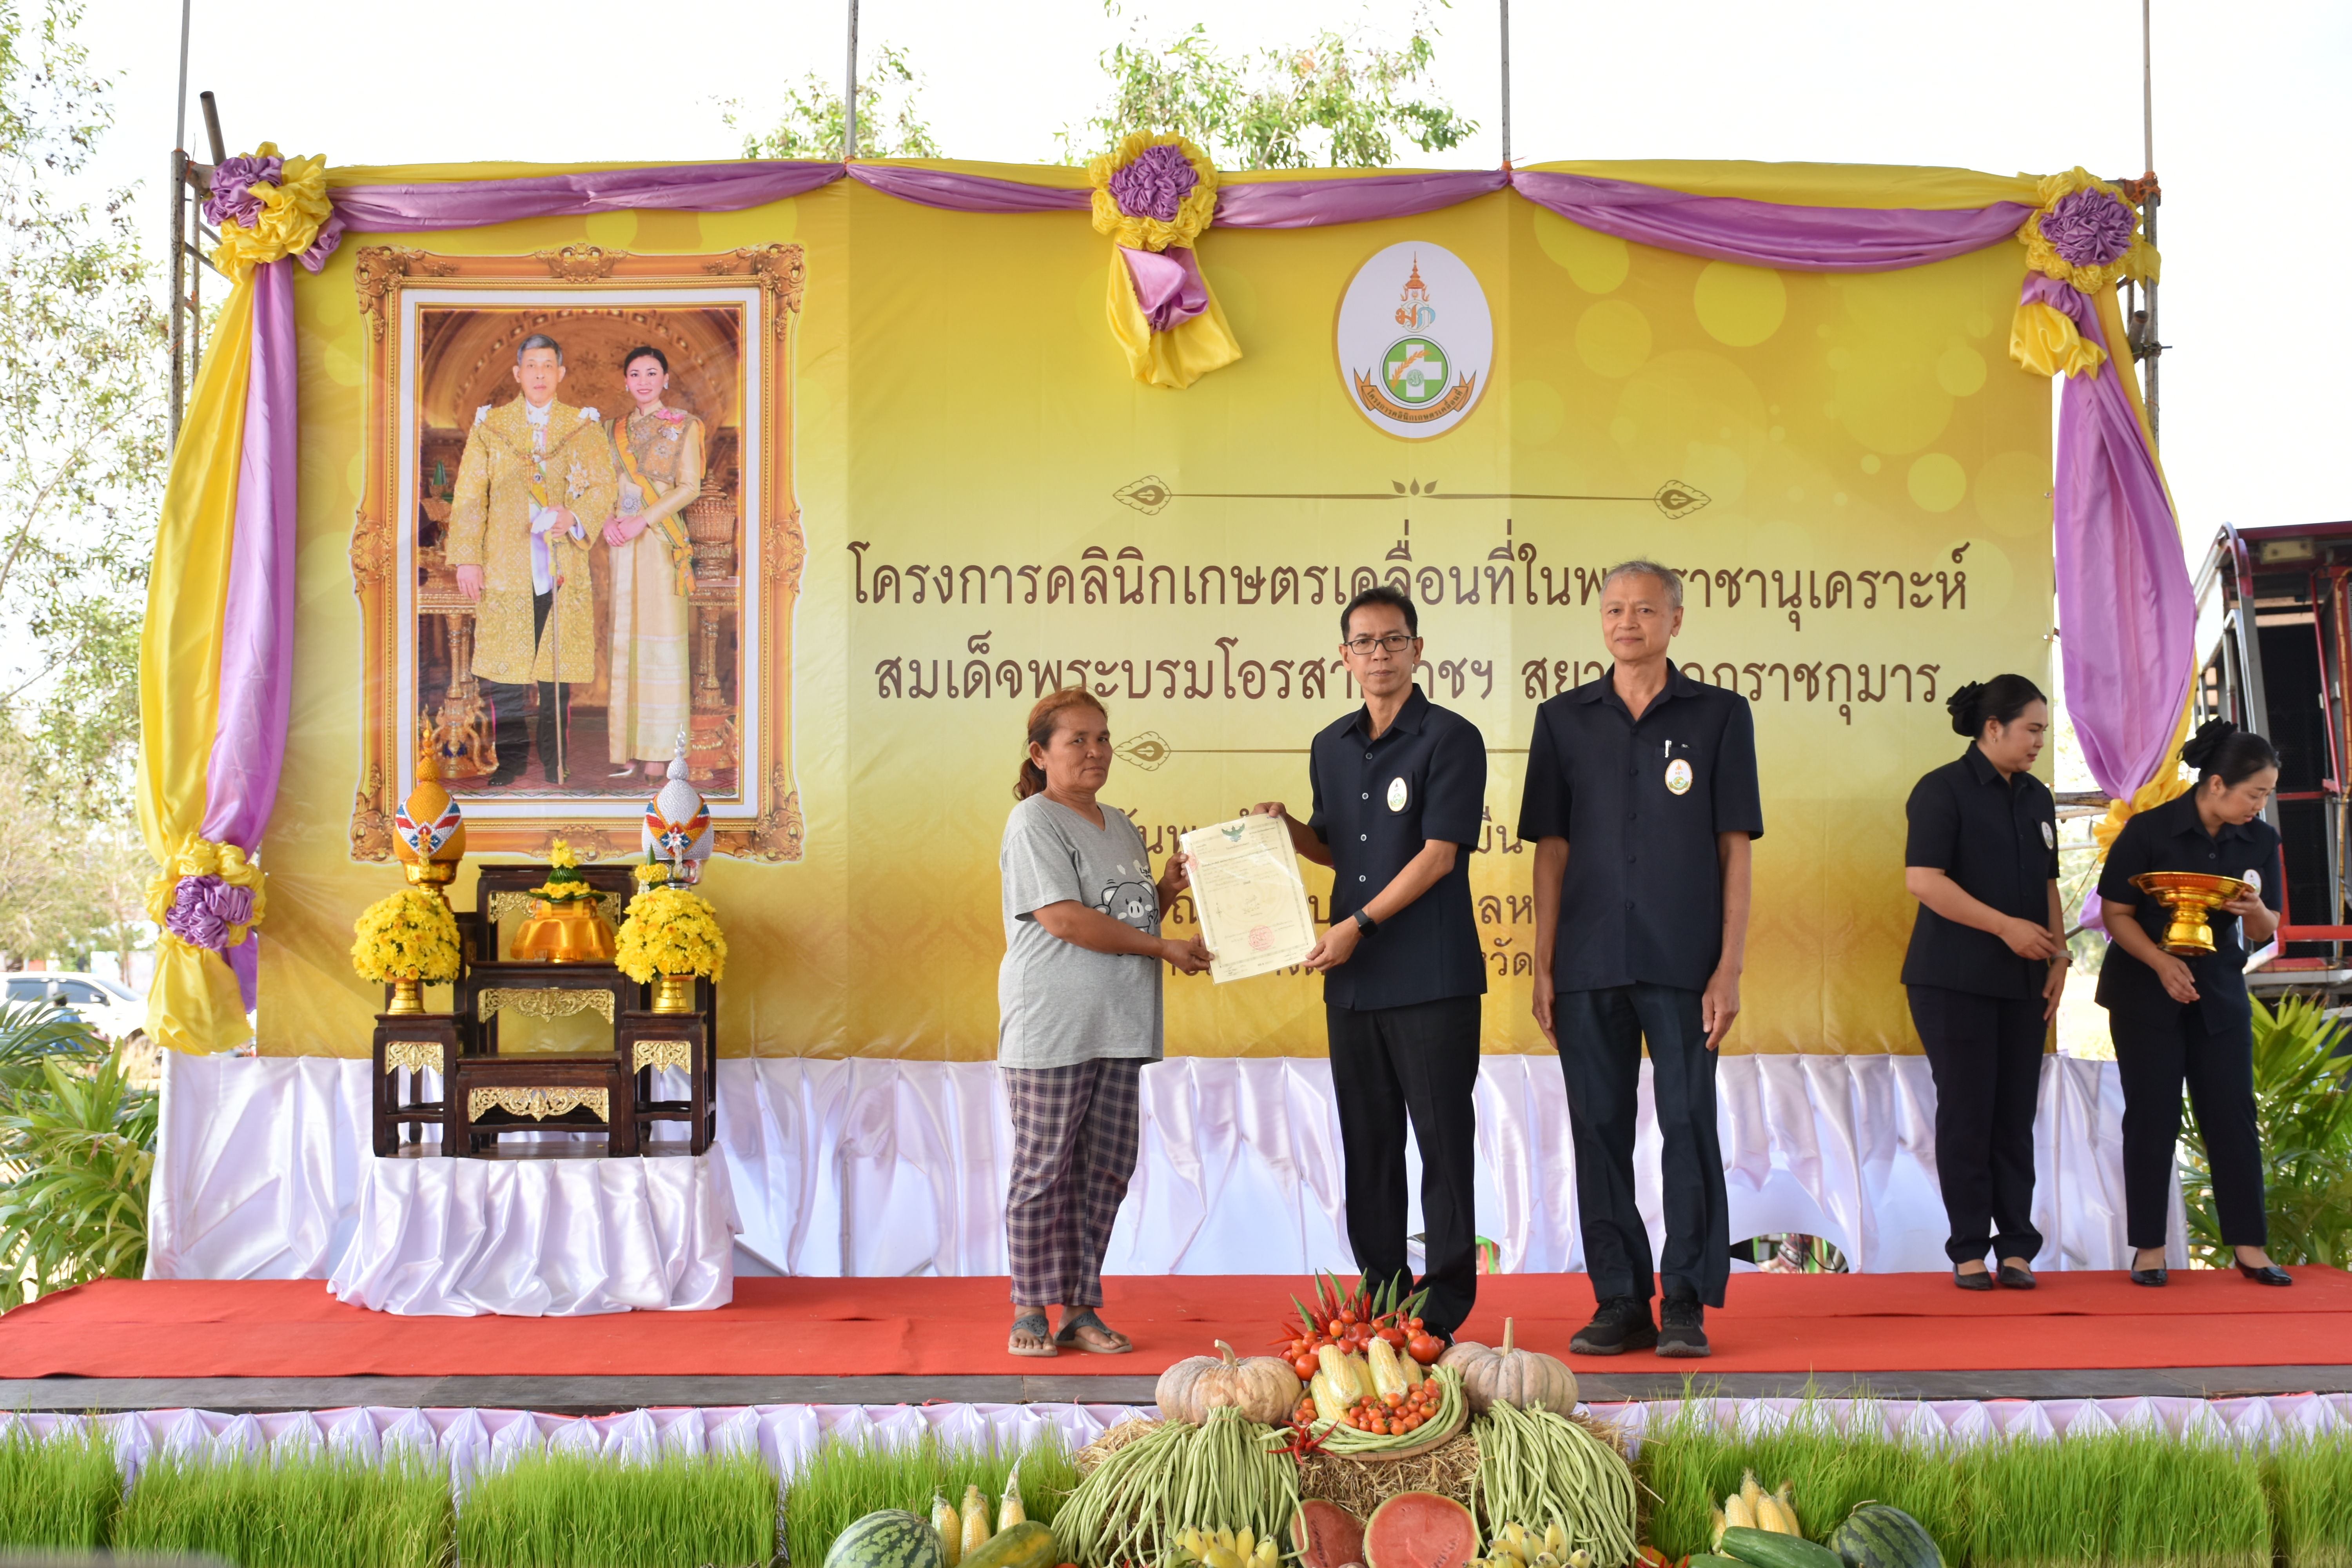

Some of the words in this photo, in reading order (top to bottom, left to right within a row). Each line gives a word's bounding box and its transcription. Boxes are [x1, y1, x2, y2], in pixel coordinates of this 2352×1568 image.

[1367, 388, 1463, 421] โครงการคลินิกเกษตรเคลื่อนที่
